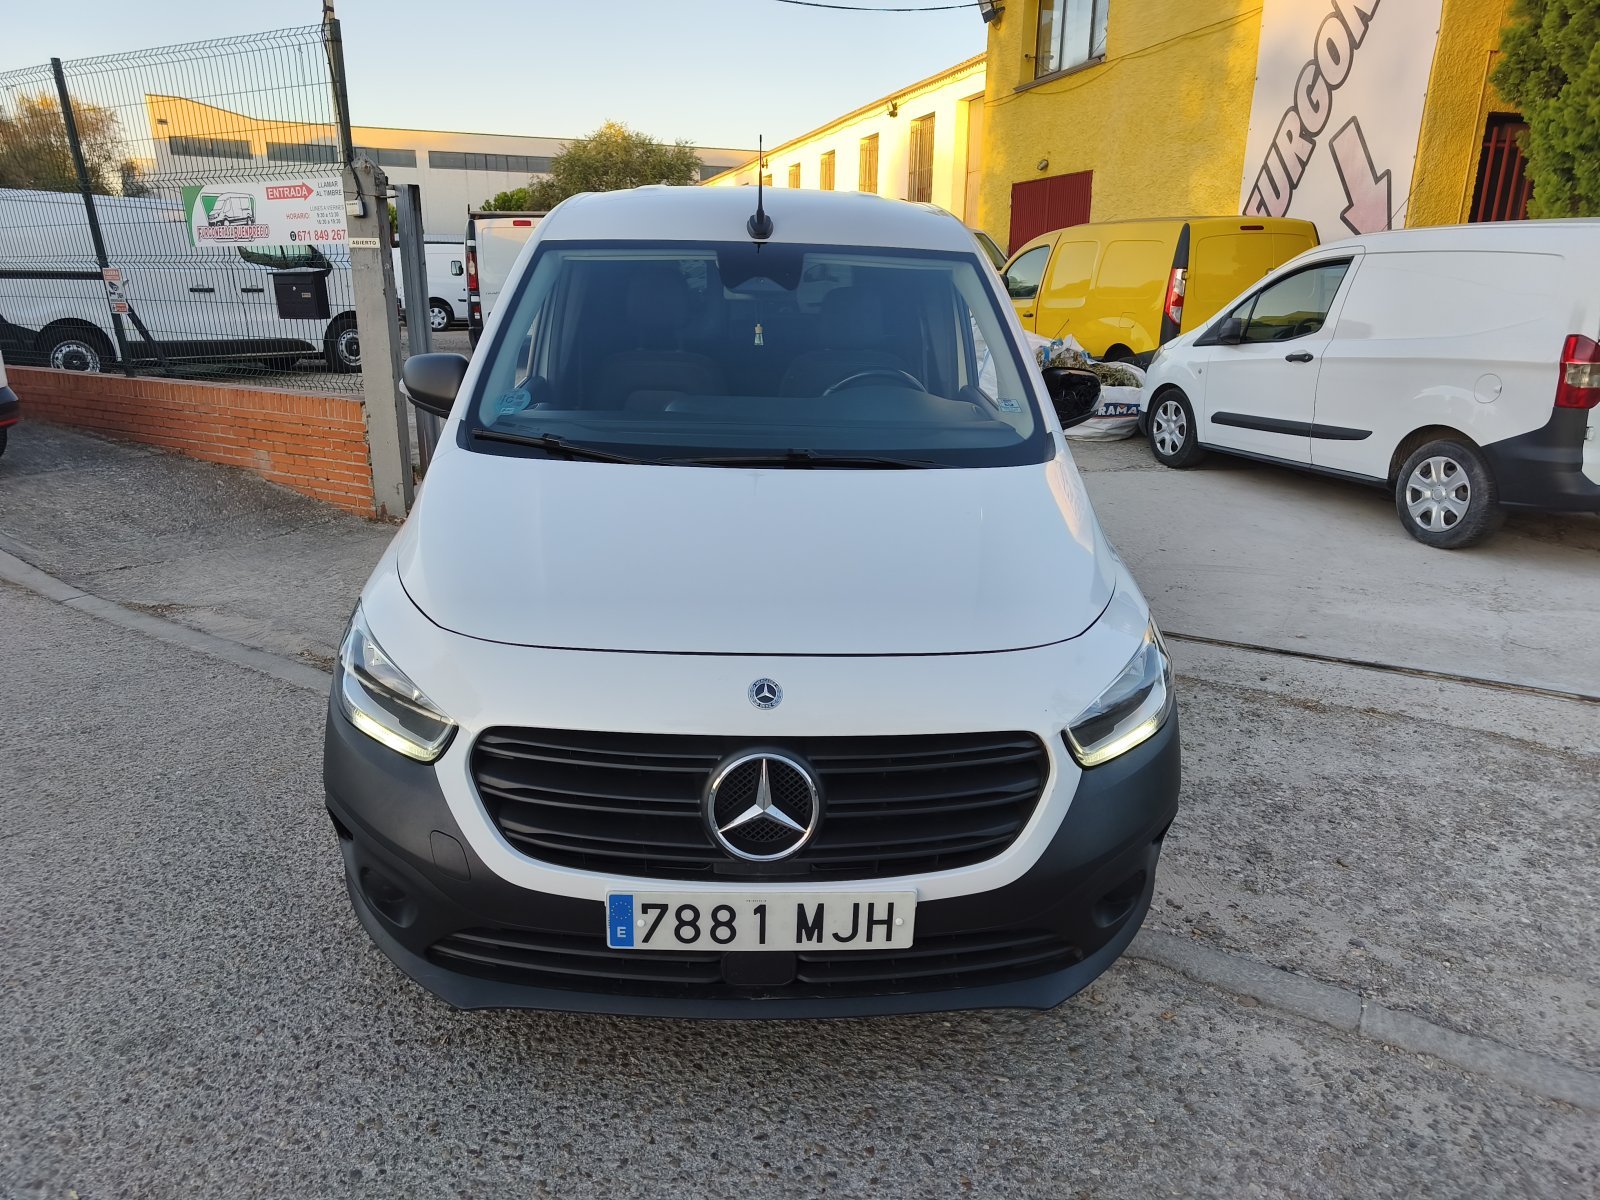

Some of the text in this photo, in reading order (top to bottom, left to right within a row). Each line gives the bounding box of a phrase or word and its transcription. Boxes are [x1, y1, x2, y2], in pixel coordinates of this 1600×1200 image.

[317, 180, 339, 188] LLAMAR
[267, 187, 308, 199] ENTRADA
[297, 229, 347, 241] 671 849 267
[1096, 405, 1140, 416] RAMA
[641, 902, 894, 945] 7881 MJH
[616, 926, 627, 938] E
